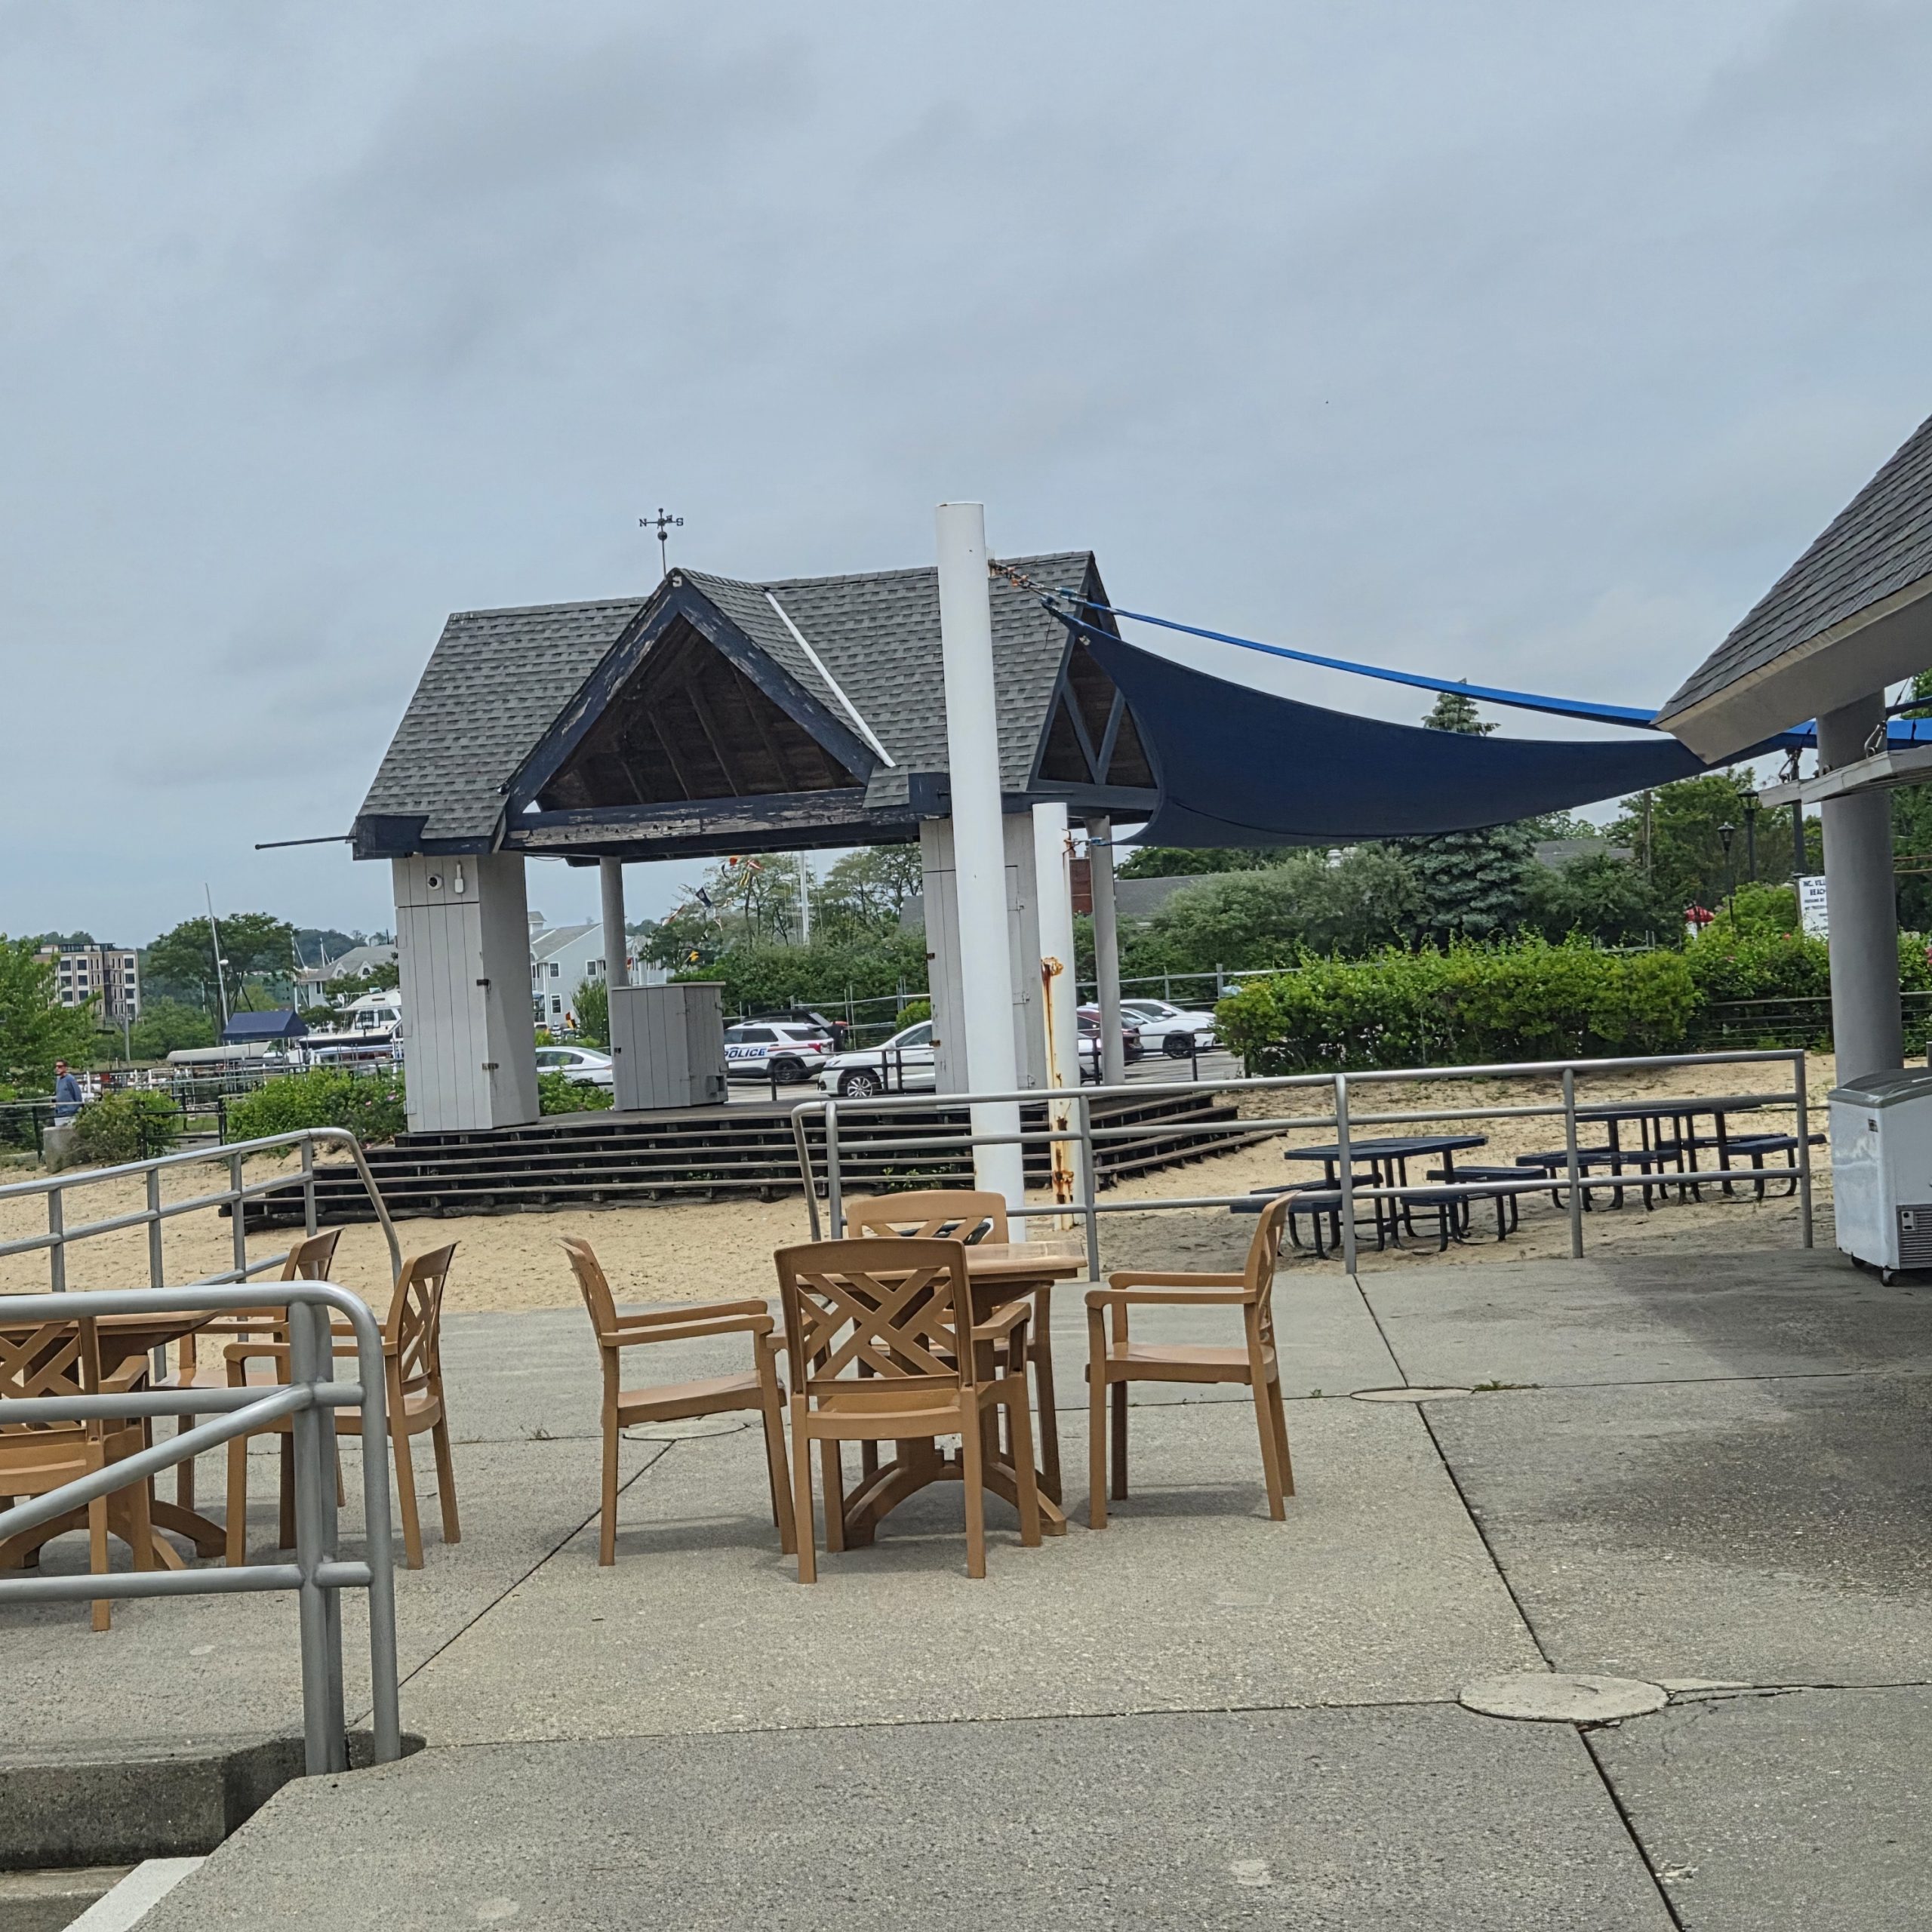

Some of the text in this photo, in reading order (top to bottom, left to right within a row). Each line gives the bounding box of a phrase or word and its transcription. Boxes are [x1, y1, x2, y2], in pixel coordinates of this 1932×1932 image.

[639, 518, 648, 528] N
[675, 517, 684, 527] S
[724, 1048, 767, 1058] POLICE
